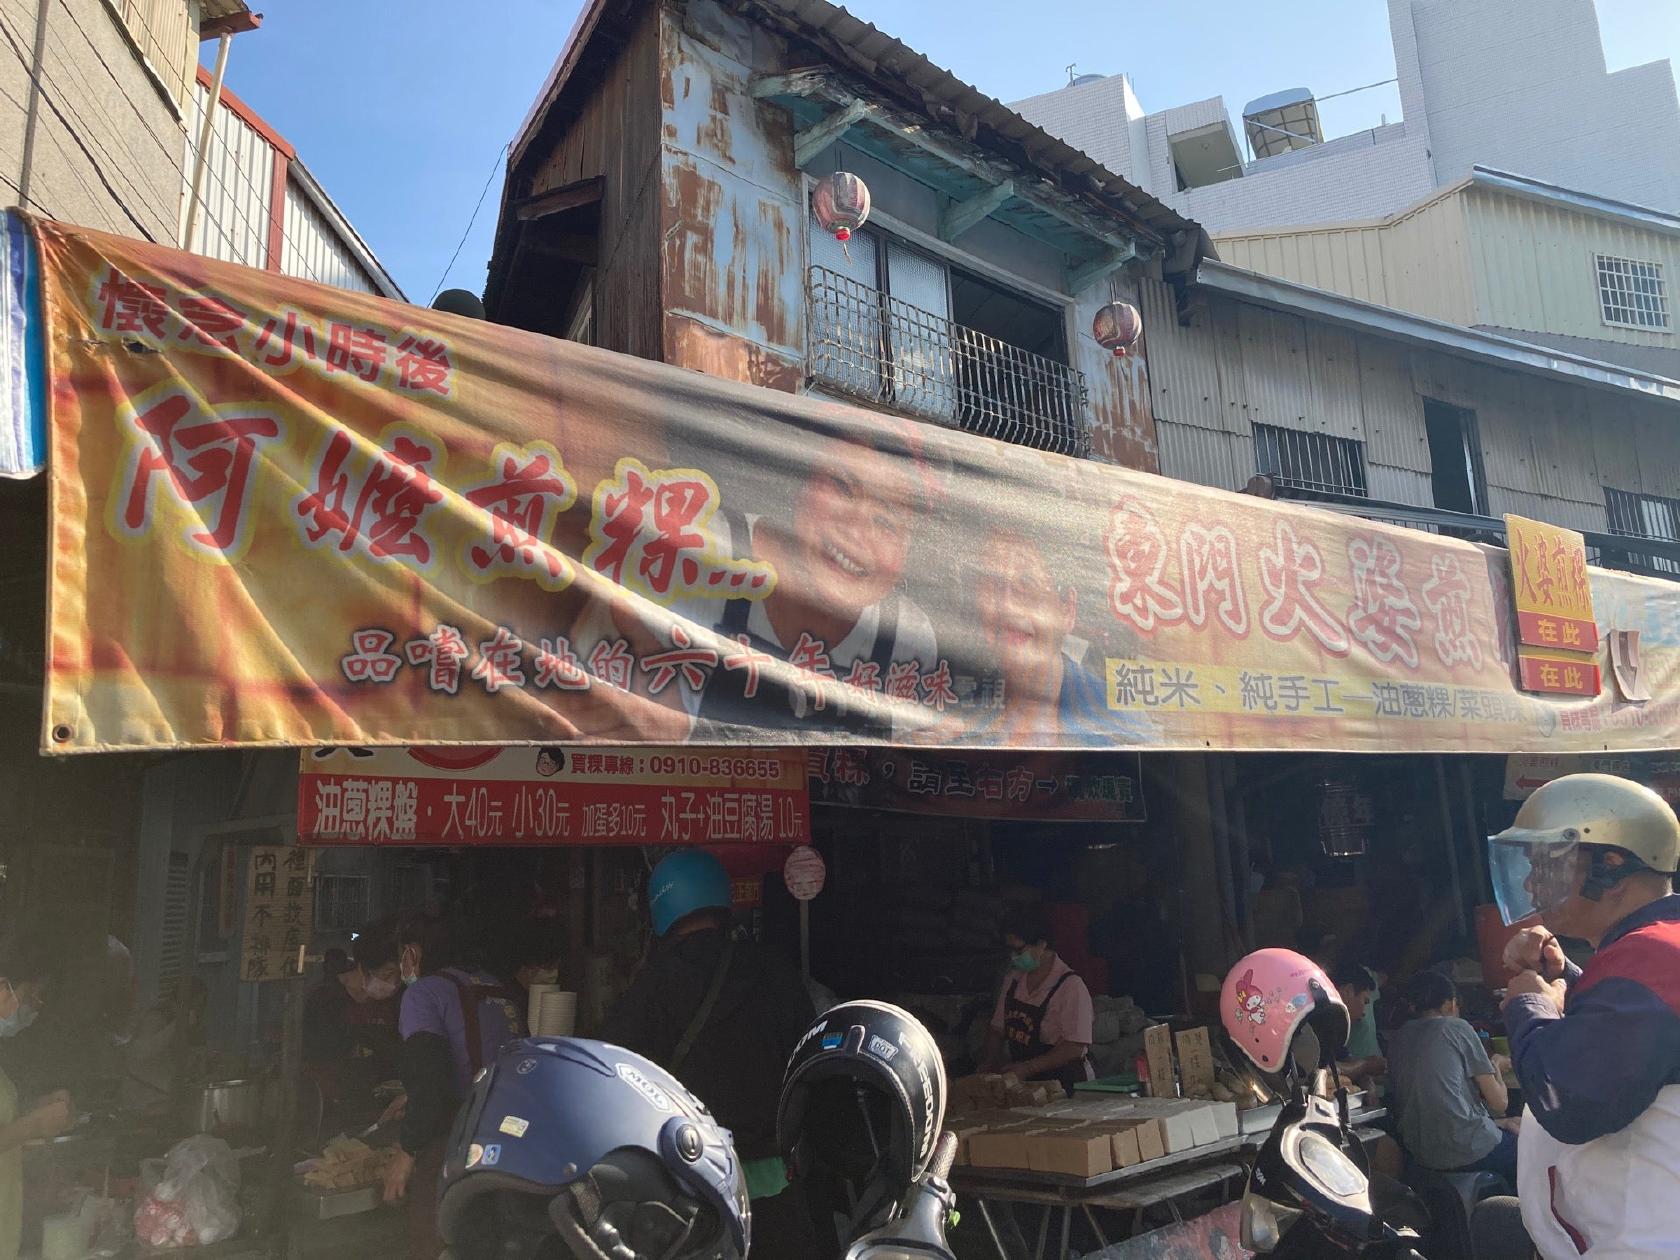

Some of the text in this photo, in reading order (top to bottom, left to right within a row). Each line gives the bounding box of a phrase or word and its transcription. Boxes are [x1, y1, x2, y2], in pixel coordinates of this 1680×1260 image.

[98, 267, 453, 397] 懷念小時後
[1538, 618, 1582, 646] 在此
[1539, 663, 1584, 690] 在此
